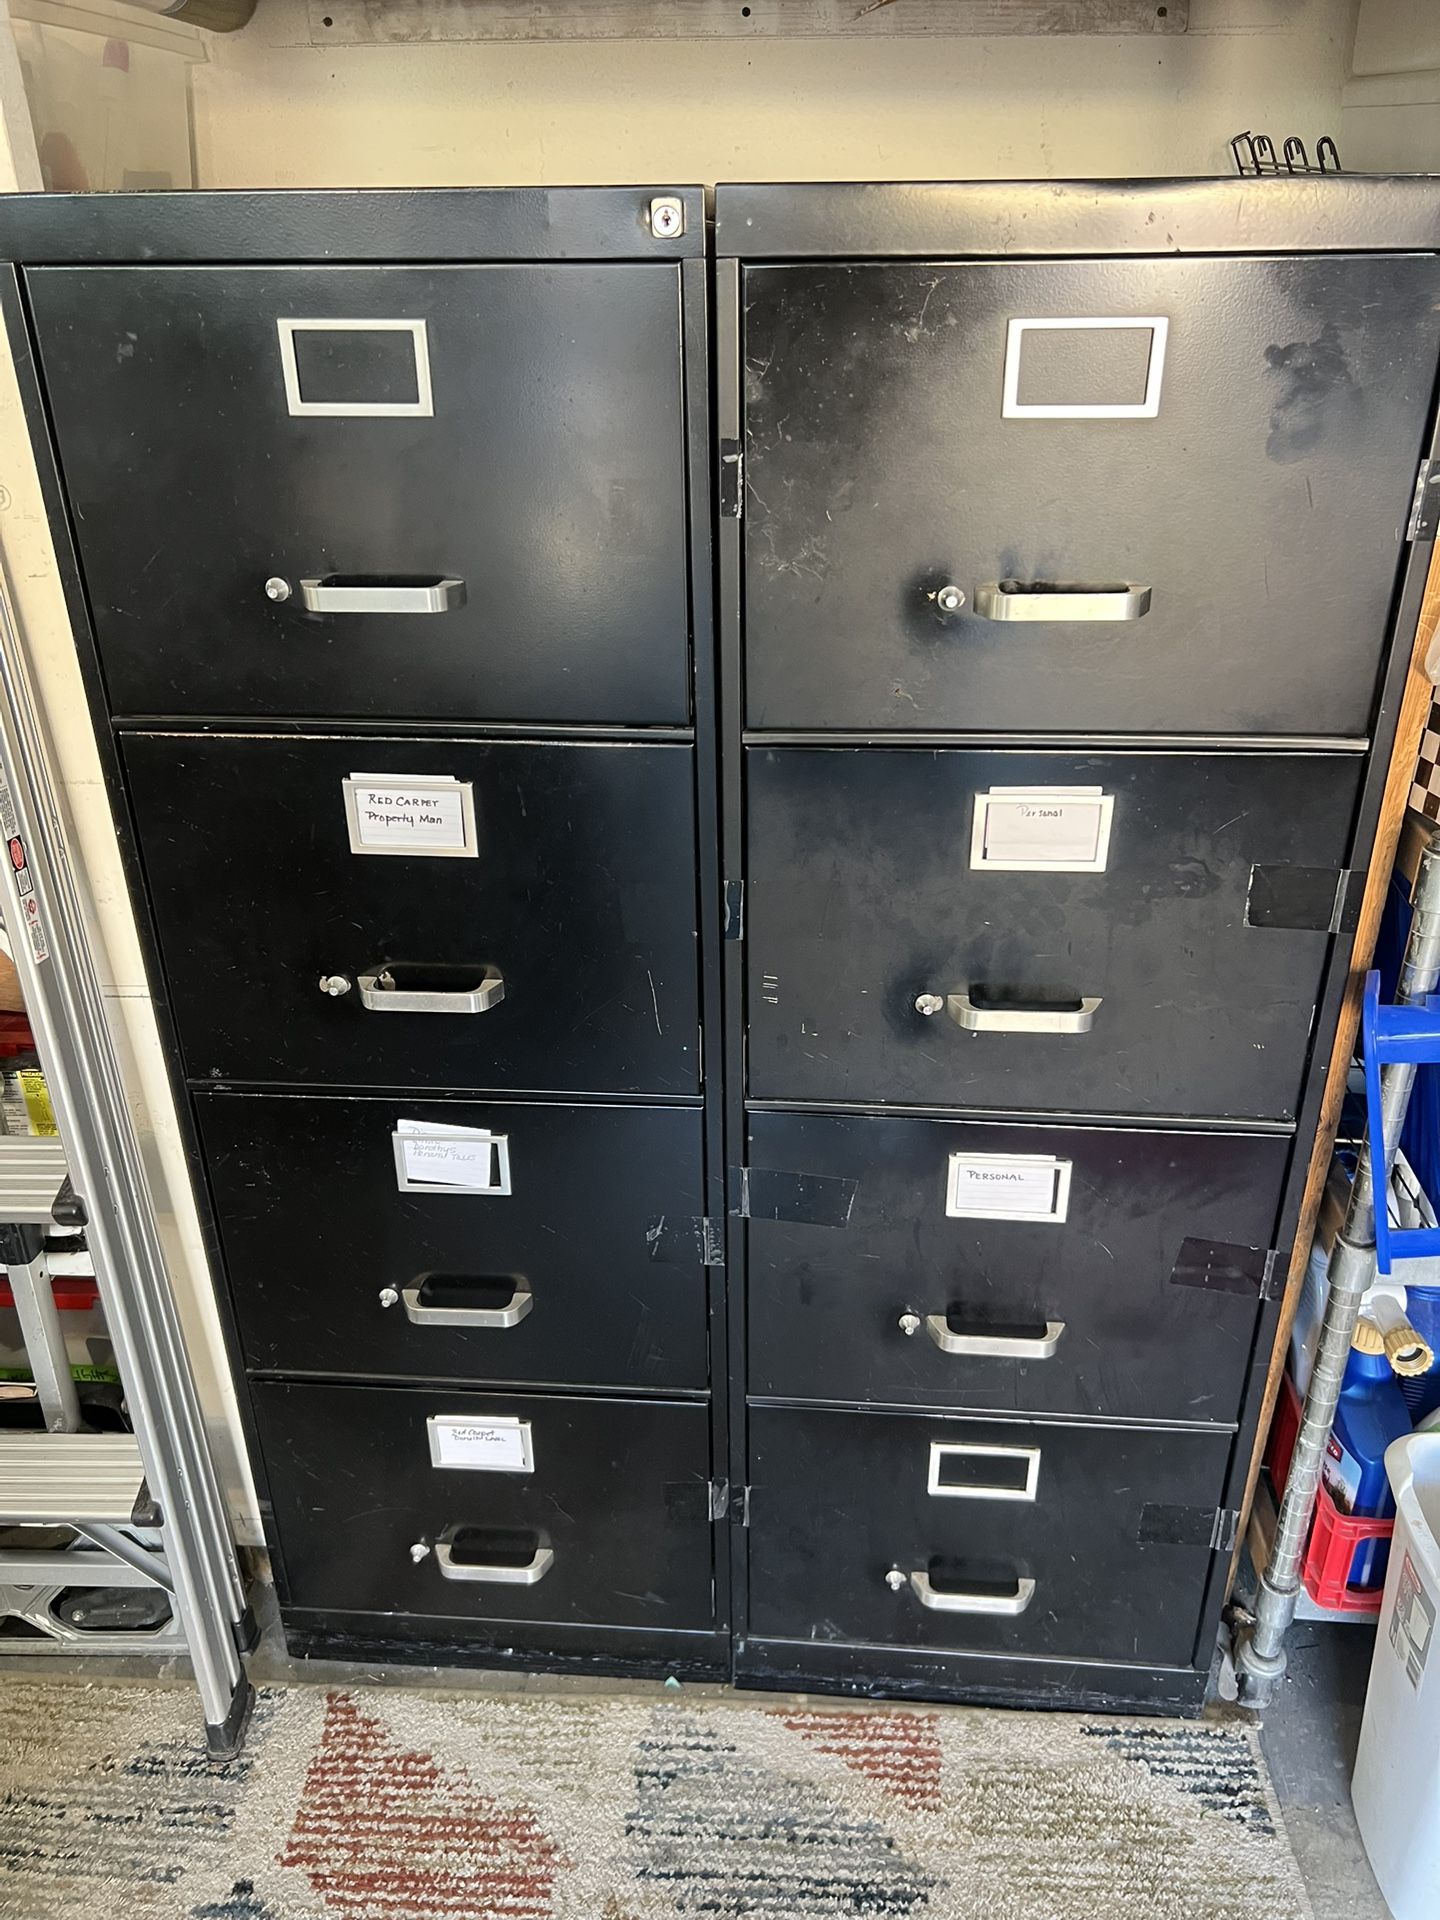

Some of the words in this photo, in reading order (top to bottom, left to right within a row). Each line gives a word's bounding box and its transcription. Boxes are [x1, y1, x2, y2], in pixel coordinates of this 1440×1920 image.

[368, 794, 393, 805] RED
[396, 797, 439, 807] CARPET
[1015, 803, 1063, 817] Personal
[365, 811, 414, 827] Property
[420, 815, 443, 824] Man
[966, 1170, 1025, 1181] PERSONAL
